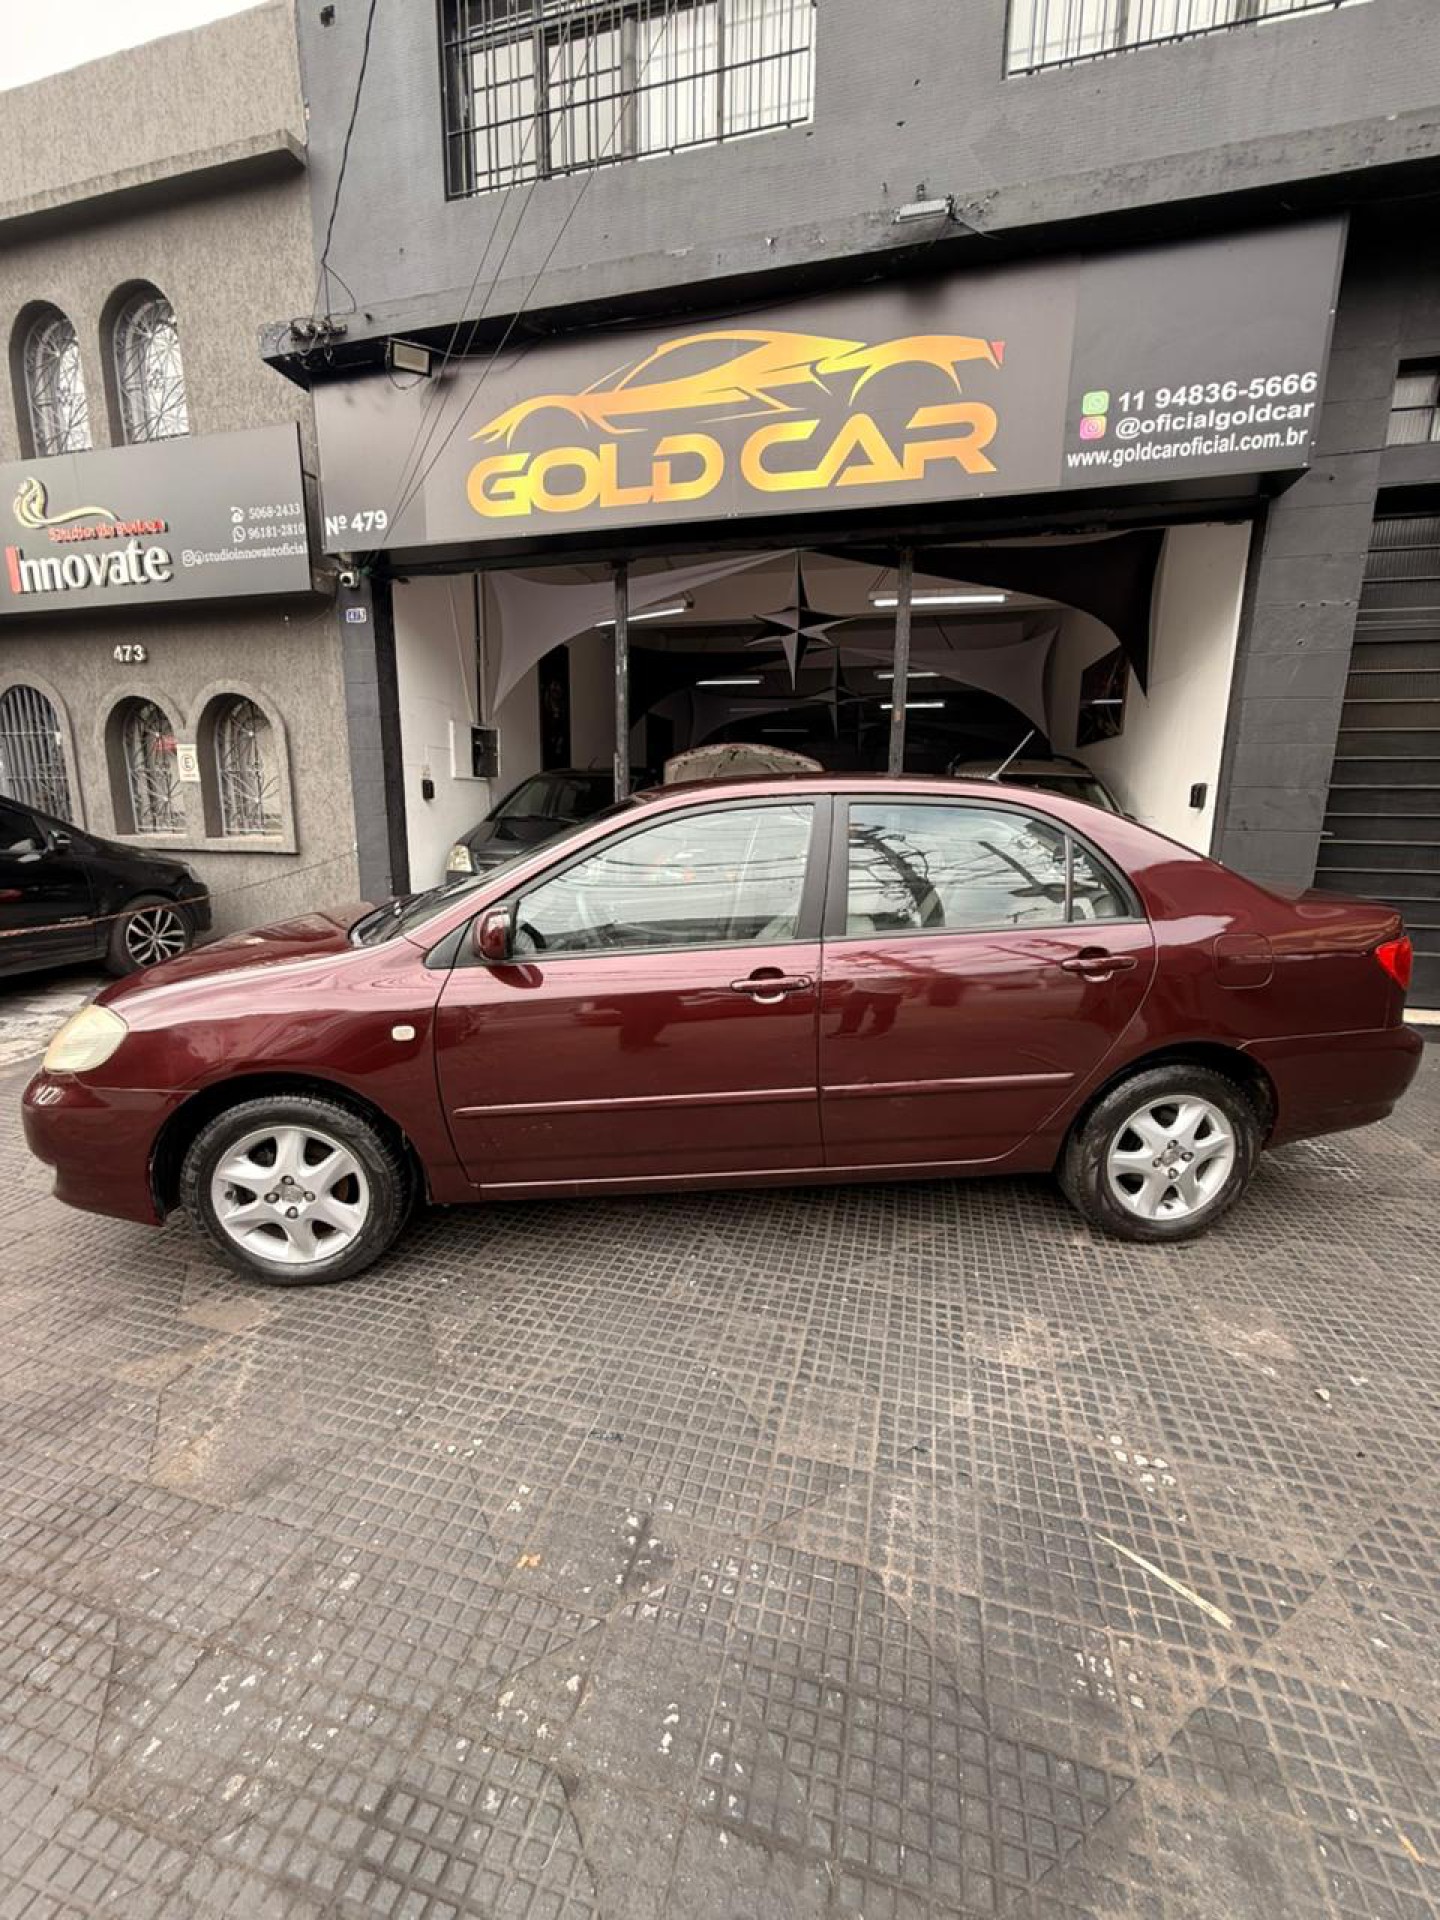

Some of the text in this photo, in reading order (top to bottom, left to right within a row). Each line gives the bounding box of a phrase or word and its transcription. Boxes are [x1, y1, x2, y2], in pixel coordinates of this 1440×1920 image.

[1118, 372, 1318, 412] 11 94836-5666
[1115, 402, 1314, 440] @oficialgoldcar
[466, 402, 998, 518] GOLD CAR
[1067, 427, 1308, 467] www.goldcaroficial.com.br
[351, 509, 388, 532] 479
[5, 538, 173, 595] Innovate
[113, 644, 146, 662] 473
